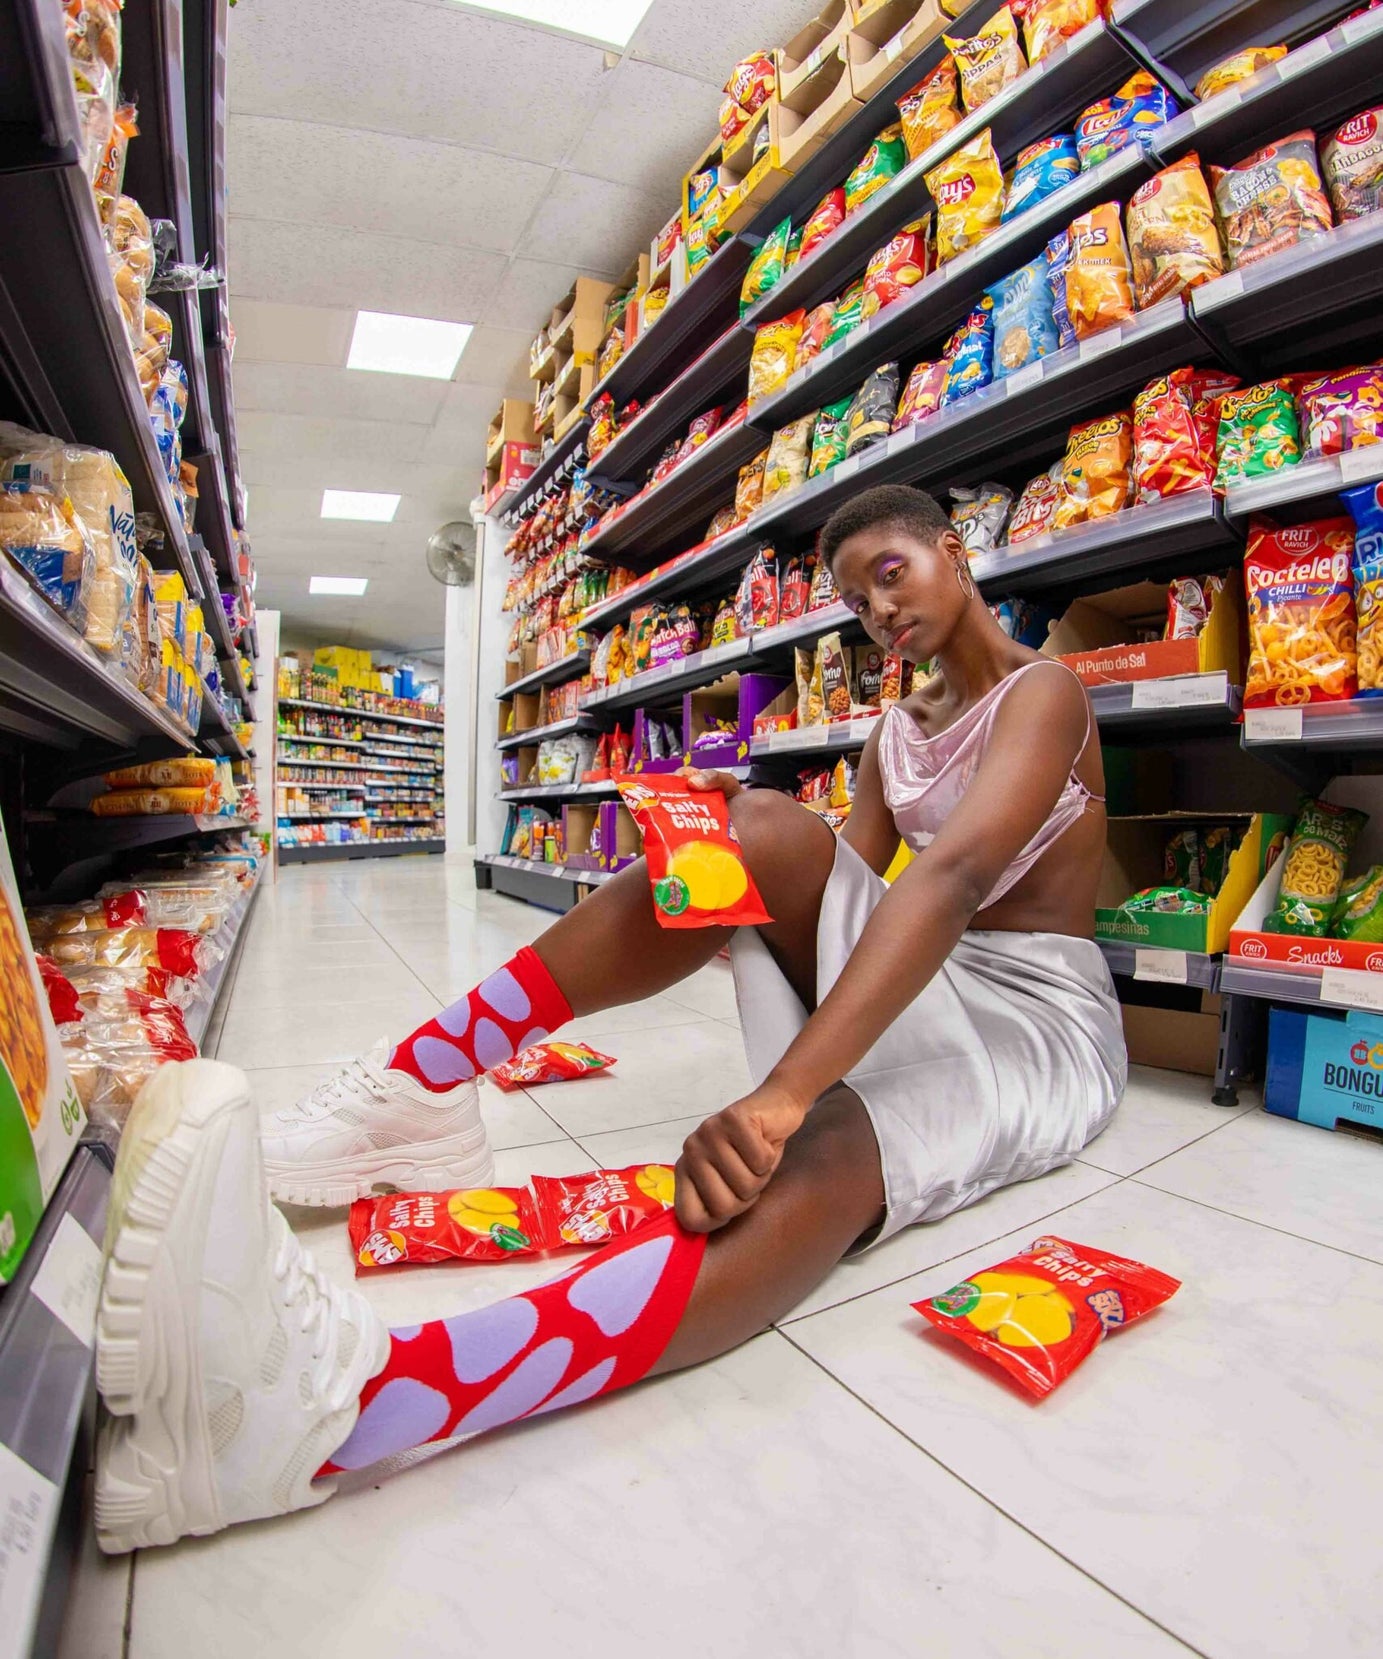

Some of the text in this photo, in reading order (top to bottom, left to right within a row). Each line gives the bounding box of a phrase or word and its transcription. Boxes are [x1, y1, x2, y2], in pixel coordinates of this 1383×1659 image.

[1330, 145, 1383, 175] BARBACO
[1281, 529, 1313, 541] FRIT
[1284, 541, 1309, 549] RAVICH
[1268, 583, 1307, 597] CHILLI
[1076, 652, 1147, 675] Al Punto de Sal
[661, 801, 711, 817] Salty
[671, 814, 720, 835] Chips
[1095, 921, 1150, 936] ampesinas
[1243, 944, 1263, 954] FRIT
[1287, 946, 1344, 965] Snacks
[1352, 1101, 1376, 1115] FRUITS
[605, 1174, 631, 1203] Chips
[388, 1199, 416, 1230] Salty
[413, 1196, 441, 1228] Chips
[1032, 1255, 1094, 1288] Chips
[1050, 1250, 1109, 1278] Salty
